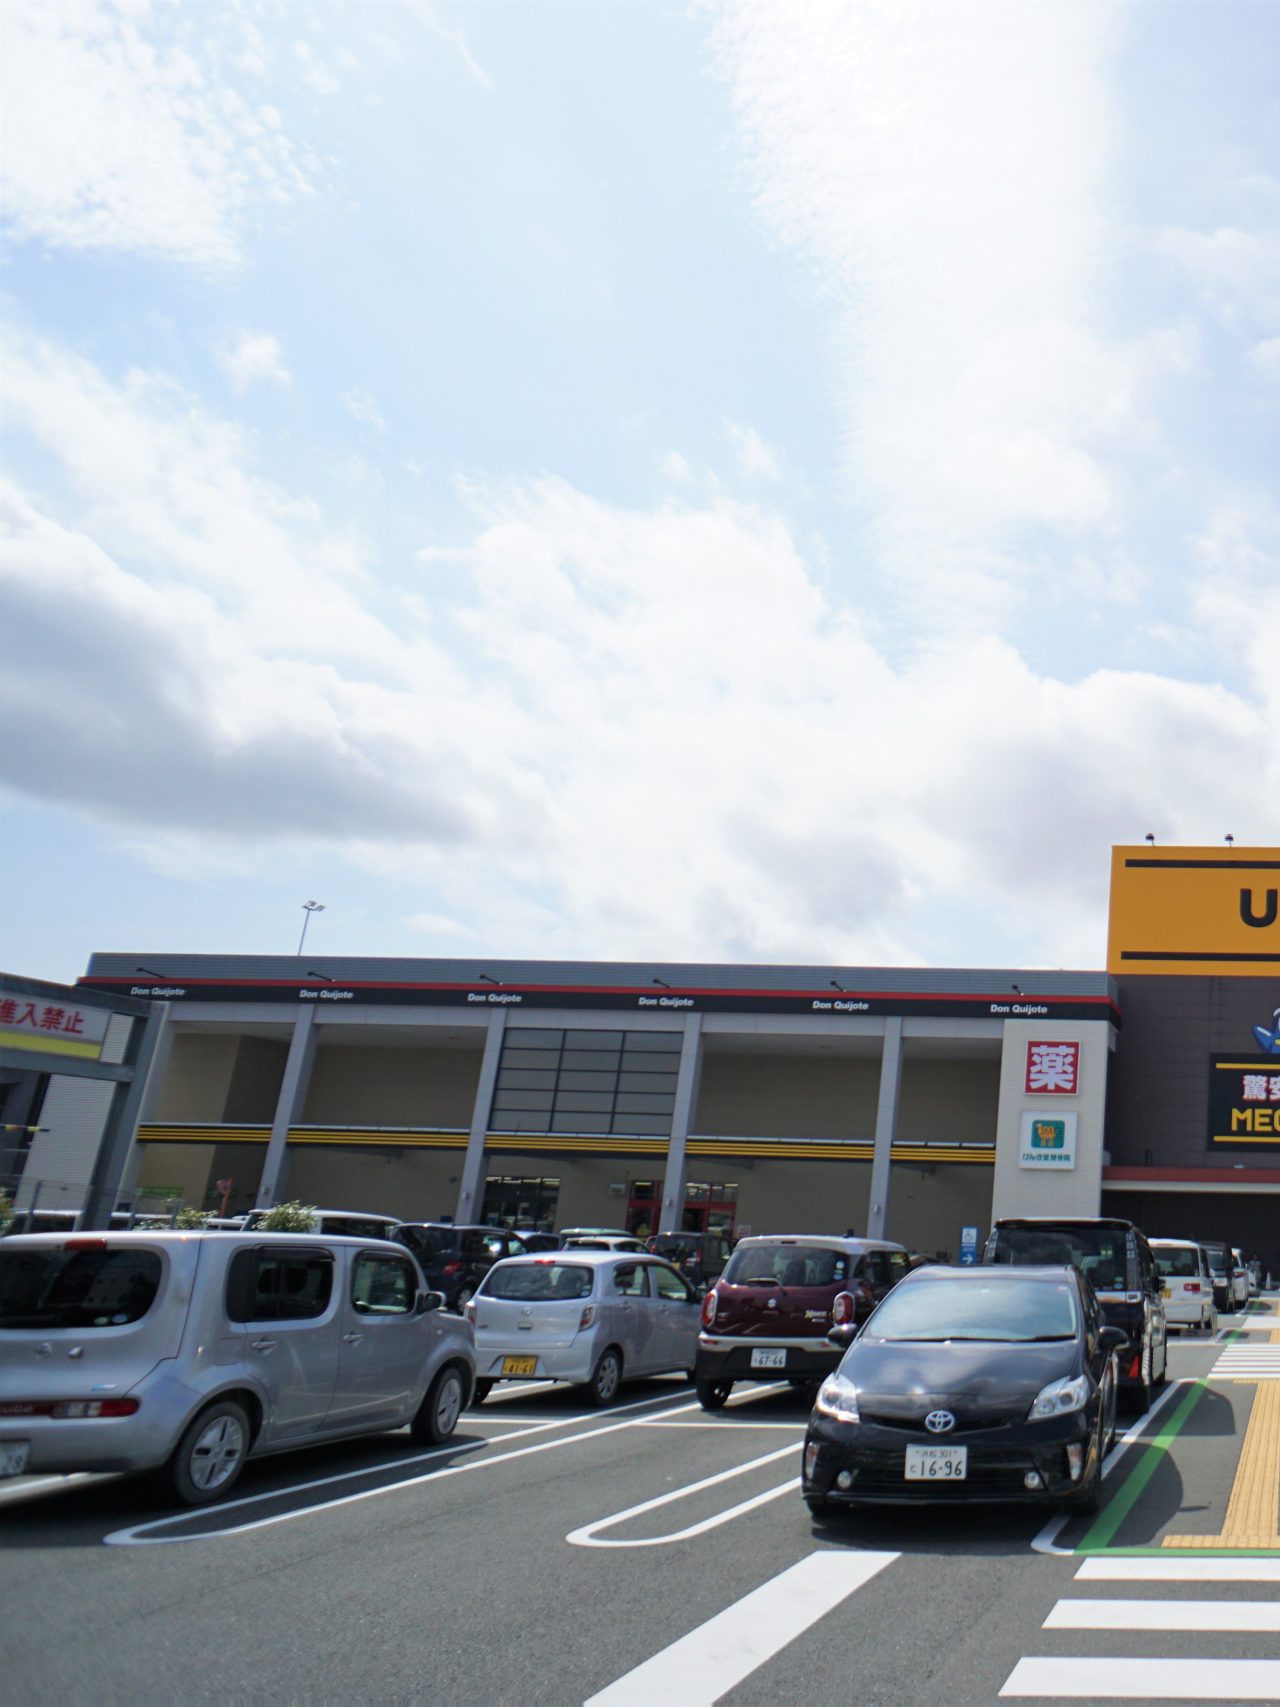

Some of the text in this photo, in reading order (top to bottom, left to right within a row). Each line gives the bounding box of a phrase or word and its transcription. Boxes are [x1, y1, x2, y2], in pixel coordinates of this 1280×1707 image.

[130, 986, 186, 997] Don Quijote
[299, 989, 354, 1000] Don Quijote
[467, 993, 522, 1003] Don Quijote
[638, 997, 694, 1007] Don Quijote
[812, 1000, 869, 1012] Don Quijote
[990, 1004, 1048, 1015] Don Quijote
[0, 998, 84, 1033] 進入禁止
[1029, 1045, 1075, 1090] 薬
[921, 1460, 962, 1476] 16-96
